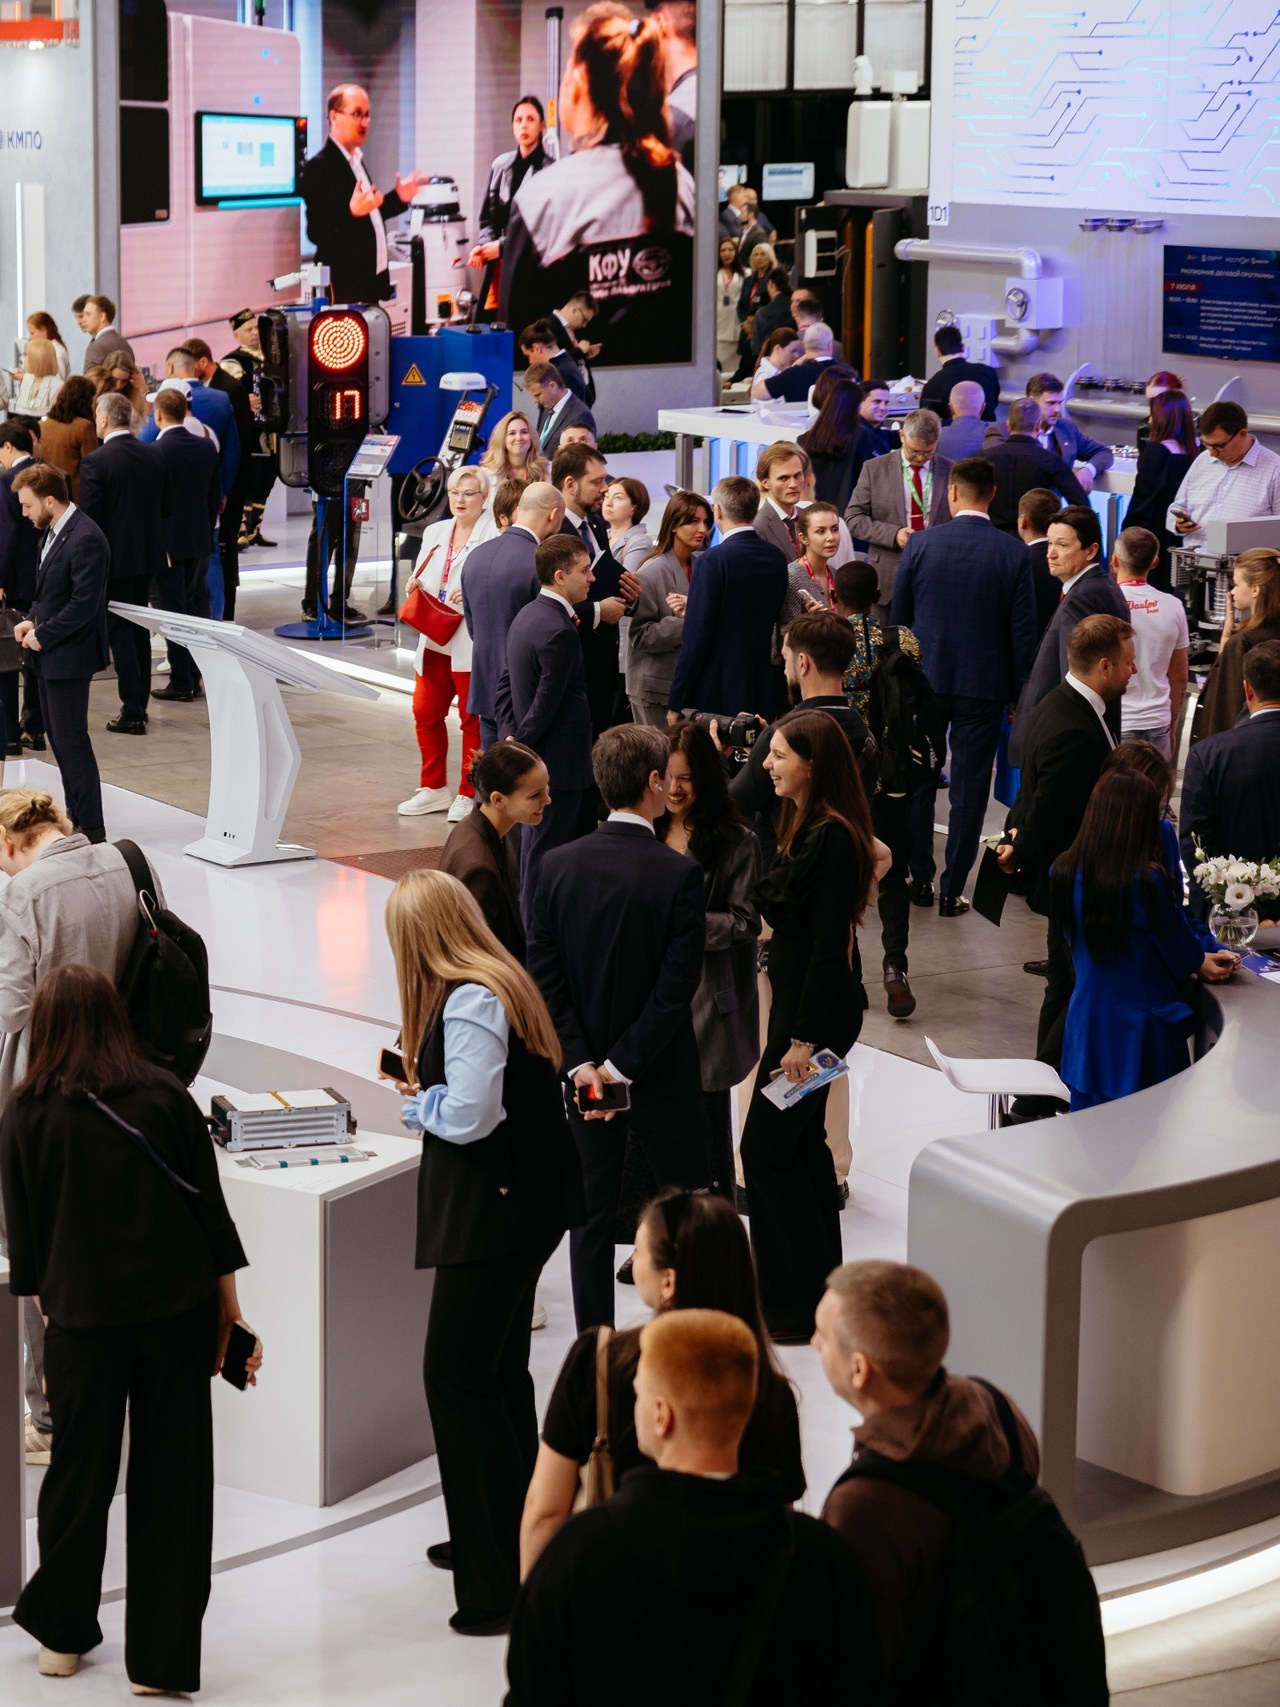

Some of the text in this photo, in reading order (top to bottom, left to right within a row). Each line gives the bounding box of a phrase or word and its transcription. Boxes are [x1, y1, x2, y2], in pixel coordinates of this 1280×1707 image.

[7, 130, 42, 149] КМПО
[589, 248, 630, 281] КФУ
[335, 389, 360, 420] 17
